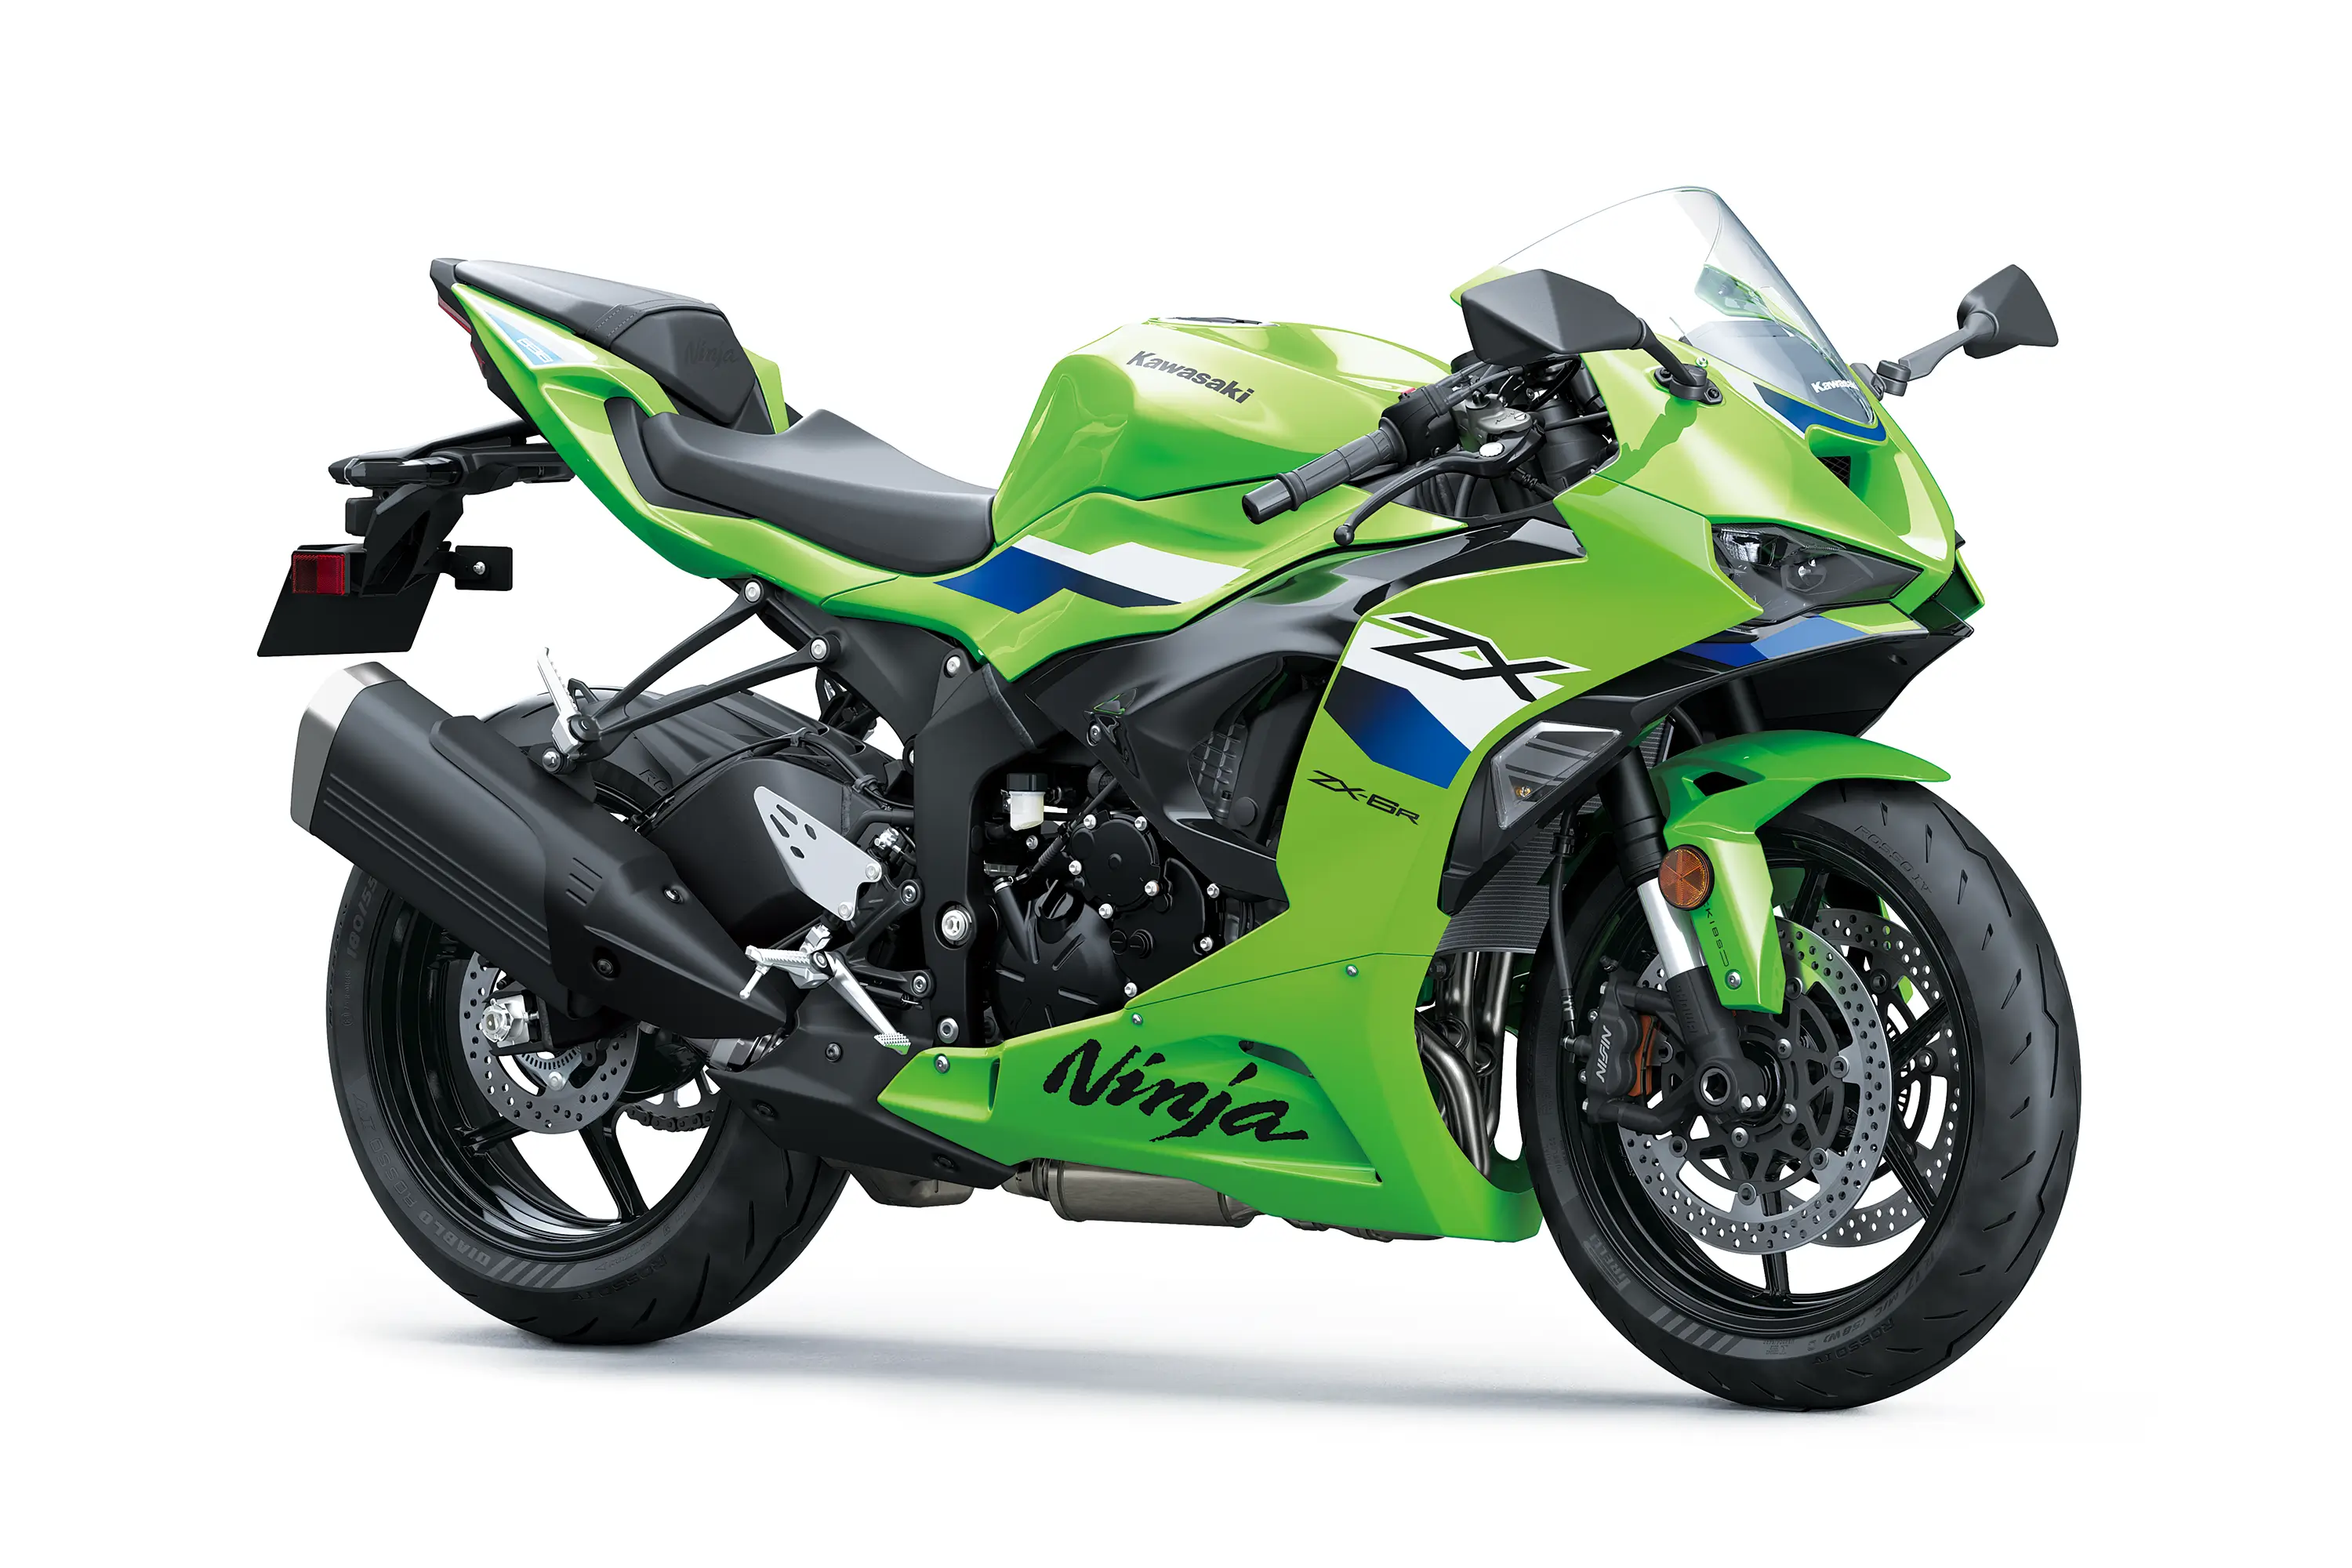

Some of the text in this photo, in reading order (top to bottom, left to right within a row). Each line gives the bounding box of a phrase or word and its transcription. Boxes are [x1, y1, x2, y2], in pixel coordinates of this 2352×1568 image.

[684, 336, 740, 371] Ninja
[1126, 350, 1255, 404] Kawasaki
[1370, 615, 1572, 703] ZX
[1307, 770, 1420, 826] ZX-6R
[1854, 825, 1933, 894] ROSSO IV
[1706, 908, 1723, 949] KIBS
[1595, 1023, 1613, 1084] NISSIN
[1043, 1039, 1308, 1142] Ninja
[352, 1092, 492, 1268] DIABLO ROSSO IV
[598, 1254, 669, 1299] ROSSO
[1582, 1232, 1632, 1293] PIRELLI
[1836, 1316, 1896, 1359] ROSSO
